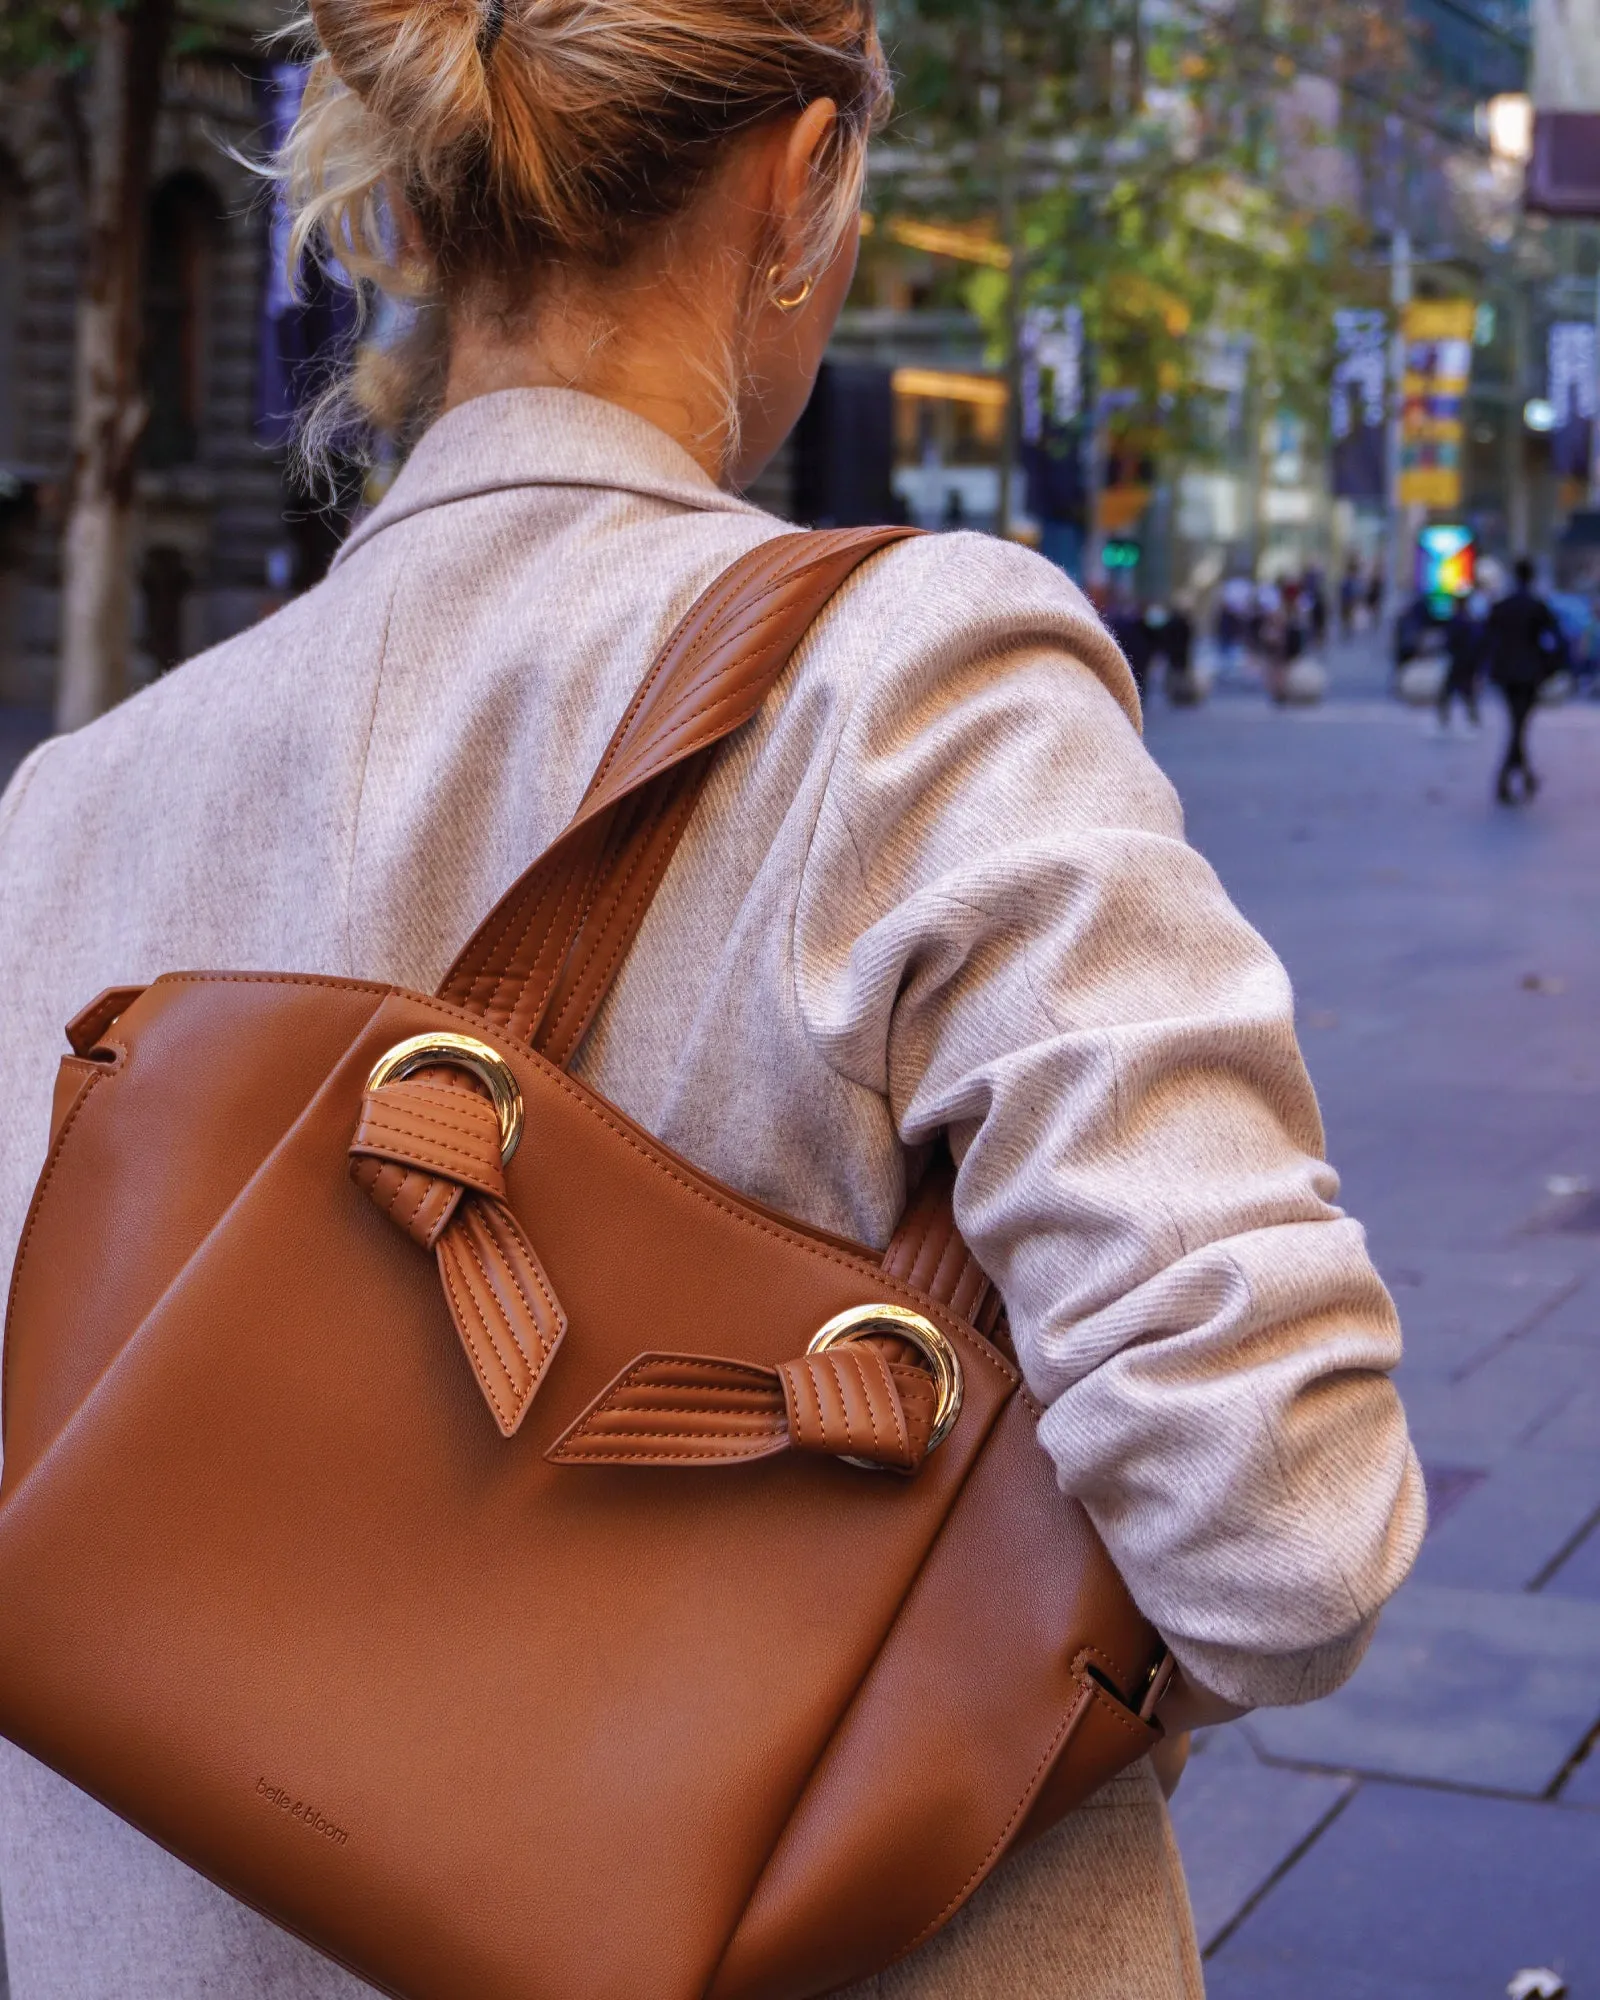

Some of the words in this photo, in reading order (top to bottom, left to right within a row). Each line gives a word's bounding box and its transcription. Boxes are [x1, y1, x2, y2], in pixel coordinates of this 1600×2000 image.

[256, 1777, 290, 1809] belle
[291, 1801, 303, 1816] &
[303, 1806, 348, 1845] bloom
